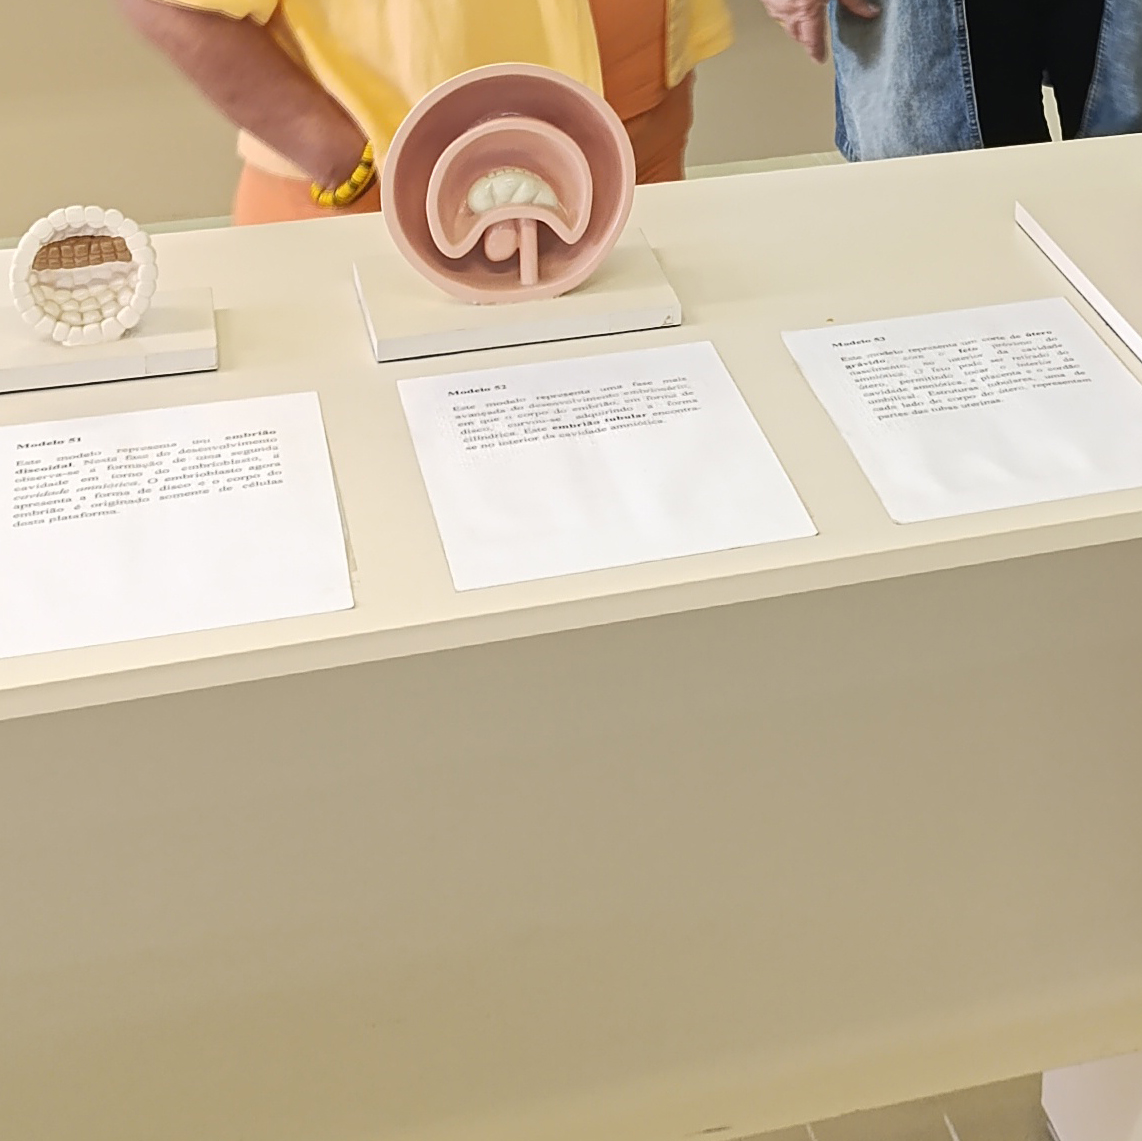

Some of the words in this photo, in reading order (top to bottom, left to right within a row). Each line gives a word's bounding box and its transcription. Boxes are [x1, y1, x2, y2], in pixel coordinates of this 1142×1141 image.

[832, 339, 871, 348] Modelo
[867, 350, 903, 358] modelo
[908, 343, 957, 353] representa
[948, 353, 983, 363] interior
[1021, 344, 1063, 352] cavidade
[959, 361, 982, 370] pode
[1012, 353, 1050, 361] retirado
[900, 373, 954, 385] permitindo
[964, 368, 988, 376] tocar
[1017, 360, 1051, 368] interior
[448, 387, 491, 396] Modelo
[863, 387, 908, 397] cavidade
[981, 371, 1021, 382] placenta
[928, 386, 979, 396] Estruturas
[948, 394, 976, 402] corpo
[1033, 378, 1092, 388] representam
[485, 398, 526, 408] modelo
[536, 390, 590, 400] representa
[529, 393, 619, 408] desenvolvimento
[646, 393, 677, 401] forma
[576, 407, 633, 419] adquirindo
[667, 398, 698, 406] forma
[878, 411, 908, 421] partes
[931, 404, 958, 412] tubas
[552, 420, 600, 430] embrião
[605, 413, 647, 422] tubular
[17, 439, 64, 449] Modelo
[56, 451, 101, 461] modelo
[117, 443, 177, 453] representa
[225, 430, 277, 440] embrião
[499, 437, 538, 446] interior
[559, 427, 607, 438] cavidade
[15, 463, 75, 474] discoidal.
[84, 457, 117, 465] Nesta
[178, 438, 277, 454] desenvolvimento
[15, 470, 80, 483] observa-se
[107, 461, 162, 470] formação
[231, 446, 279, 456] segunda
[13, 488, 69, 501] cavidade
[164, 468, 242, 482] embrioblasto
[248, 462, 281, 471] agora
[14, 480, 69, 492] cavidade
[13, 498, 72, 510] apresenta
[95, 491, 130, 499] forma
[159, 482, 191, 491] disco
[226, 473, 261, 482] corpo
[13, 507, 64, 518] embrião
[91, 497, 149, 508] originado
[159, 489, 210, 500] somente
[242, 480, 283, 489] células
[13, 519, 45, 527] desta
